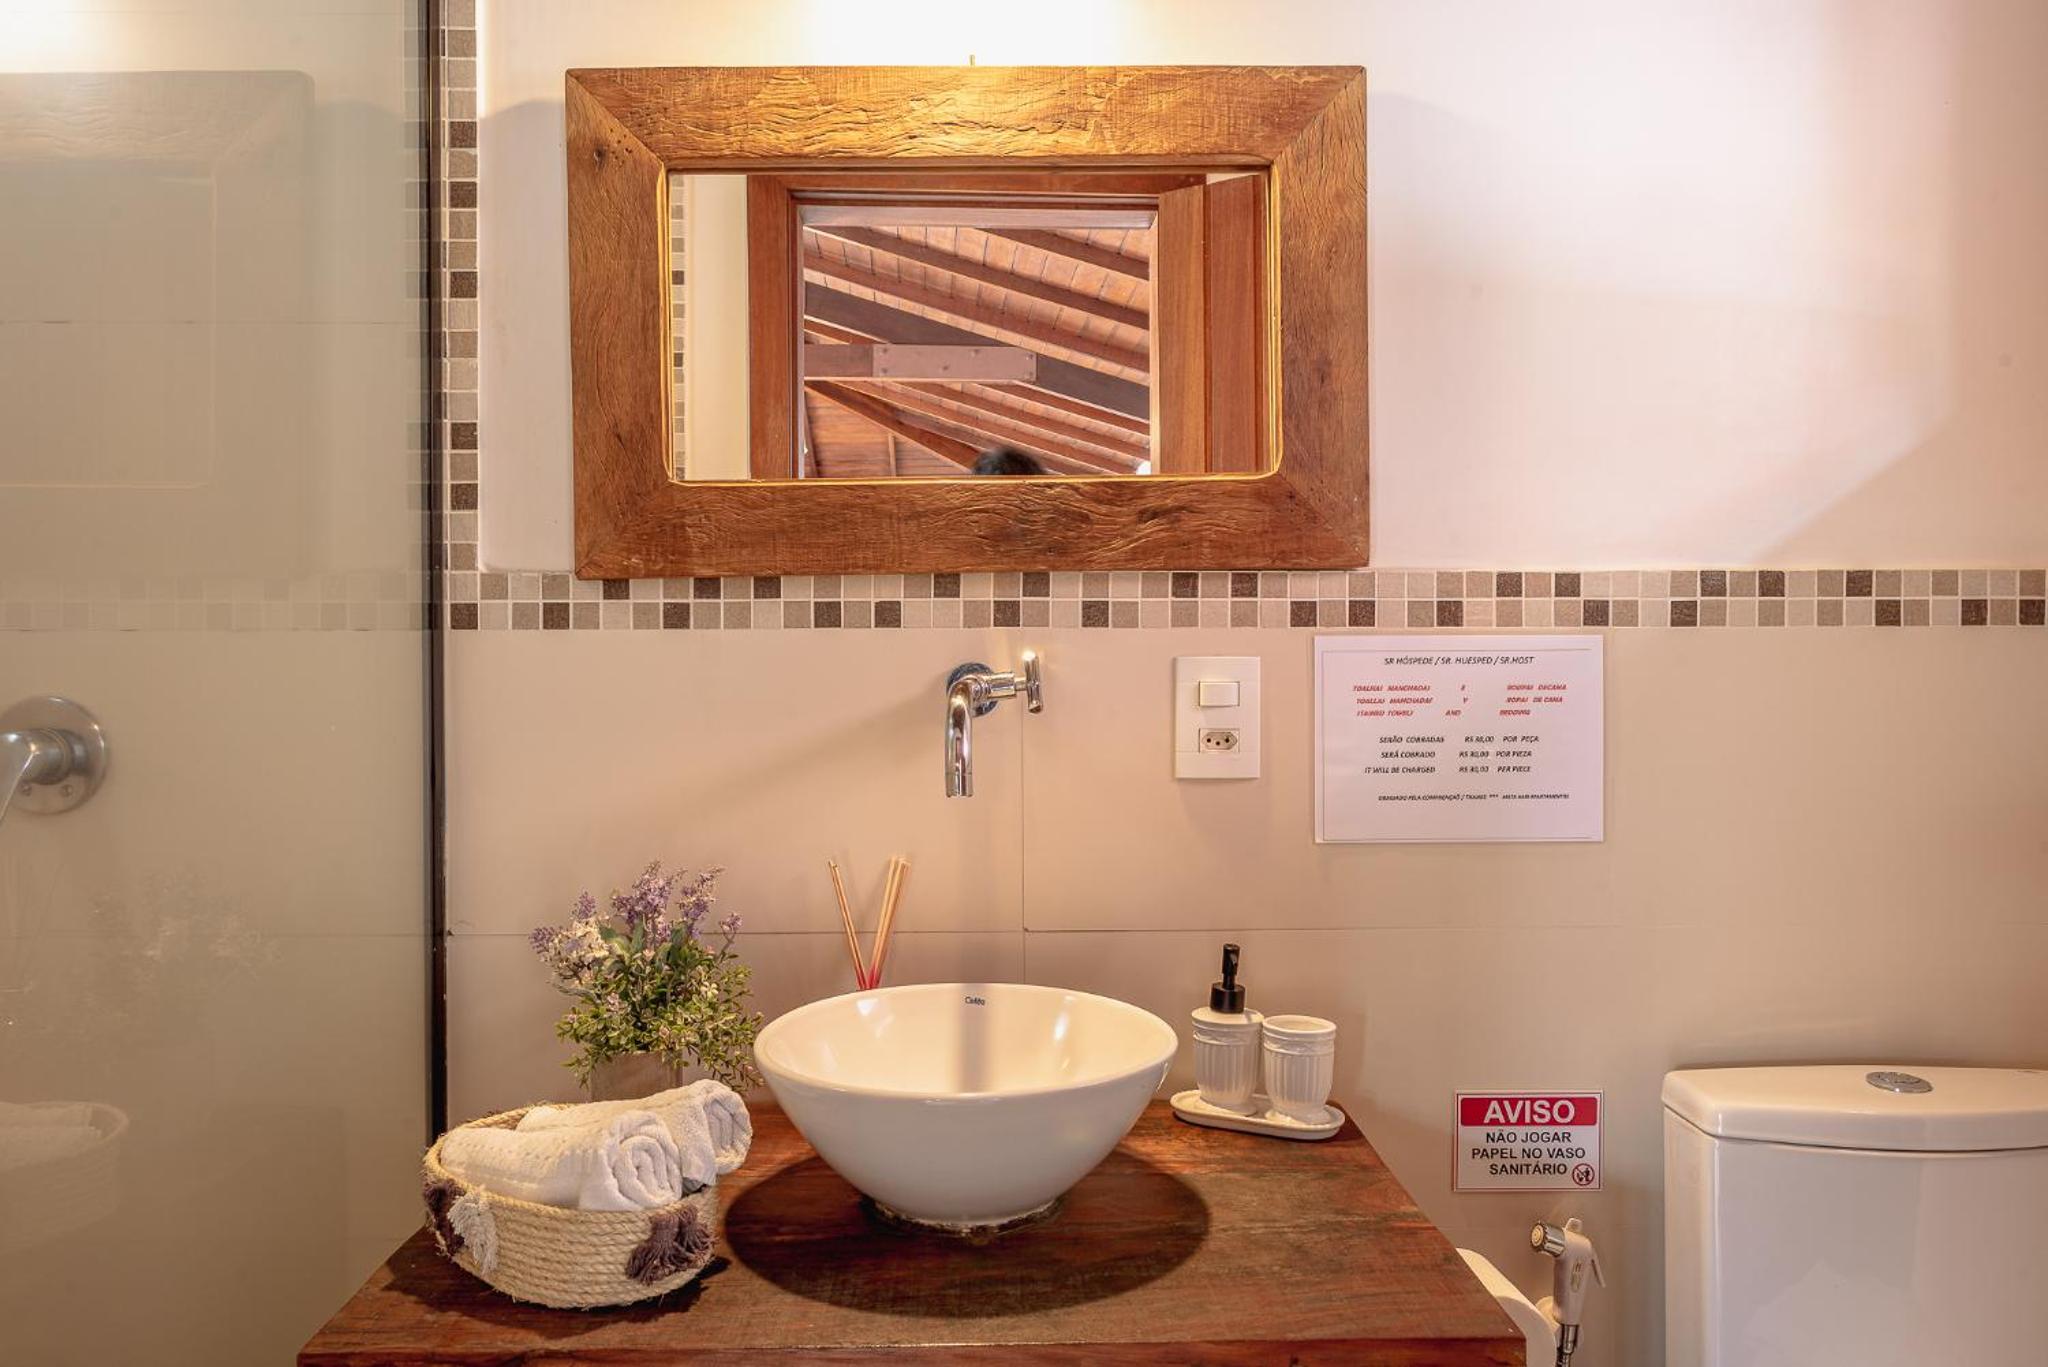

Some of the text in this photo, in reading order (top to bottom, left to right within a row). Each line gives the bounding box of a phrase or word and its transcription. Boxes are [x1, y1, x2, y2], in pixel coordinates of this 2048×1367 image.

[1483, 1099, 1576, 1124] AVISO
[1486, 1128, 1572, 1144] NÃO JOGAR
[1471, 1147, 1586, 1160] PAPEL NO VASO
[1488, 1160, 1568, 1175] SANITÁRIO
